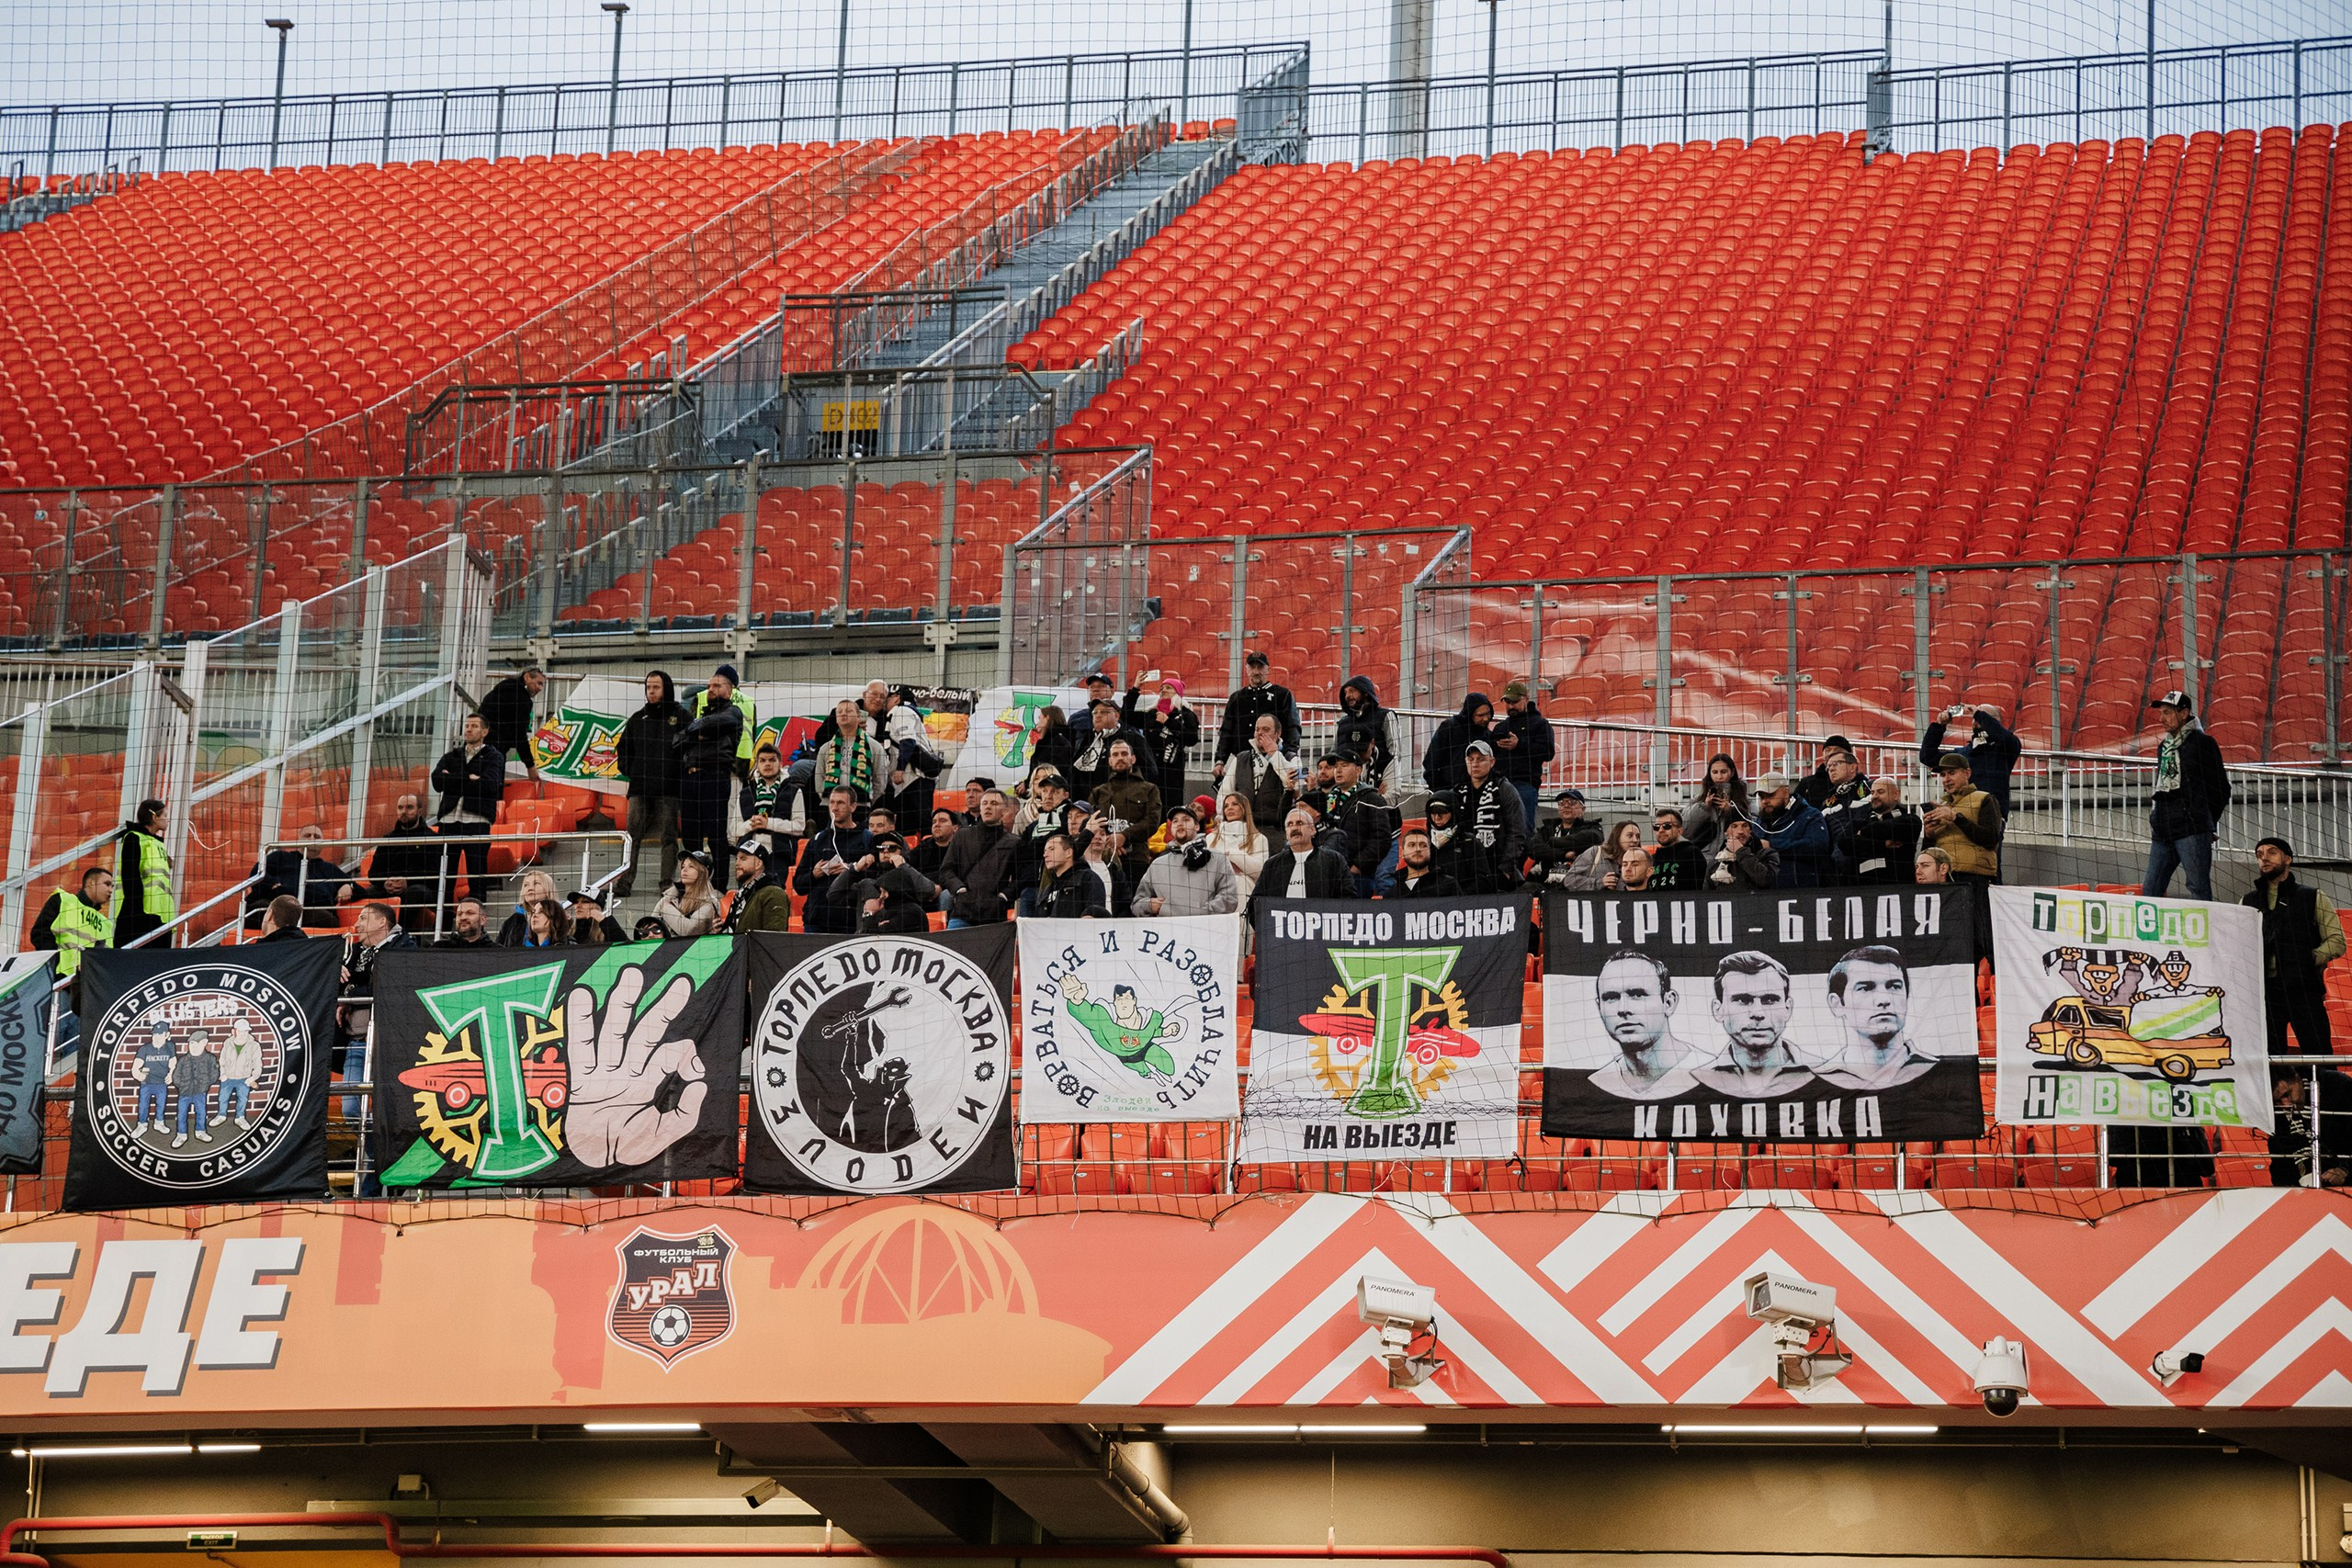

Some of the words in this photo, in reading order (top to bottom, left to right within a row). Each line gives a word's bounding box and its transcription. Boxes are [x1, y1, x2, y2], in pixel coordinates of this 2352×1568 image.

[1271, 909, 1393, 945] ТОРПЕДО
[1405, 906, 1517, 942] МОСКВА
[1099, 930, 1120, 954] И
[96, 973, 198, 1062] TORPEDO
[219, 972, 301, 1052] MOSCOW
[97, 1104, 169, 1178] SOCCER
[198, 1097, 292, 1178] CASUALS
[1303, 1124, 1338, 1149] НА
[1344, 1121, 1457, 1150] ВЫЕЗДЕ
[633, 1247, 719, 1257] ФУТБОЛЬНЫЙ
[659, 1256, 693, 1264] КЛУБ
[627, 1261, 719, 1313] УРАЛ
[1370, 1284, 1416, 1297] PANOMERA
[1774, 1281, 1818, 1296] PANOMERA
